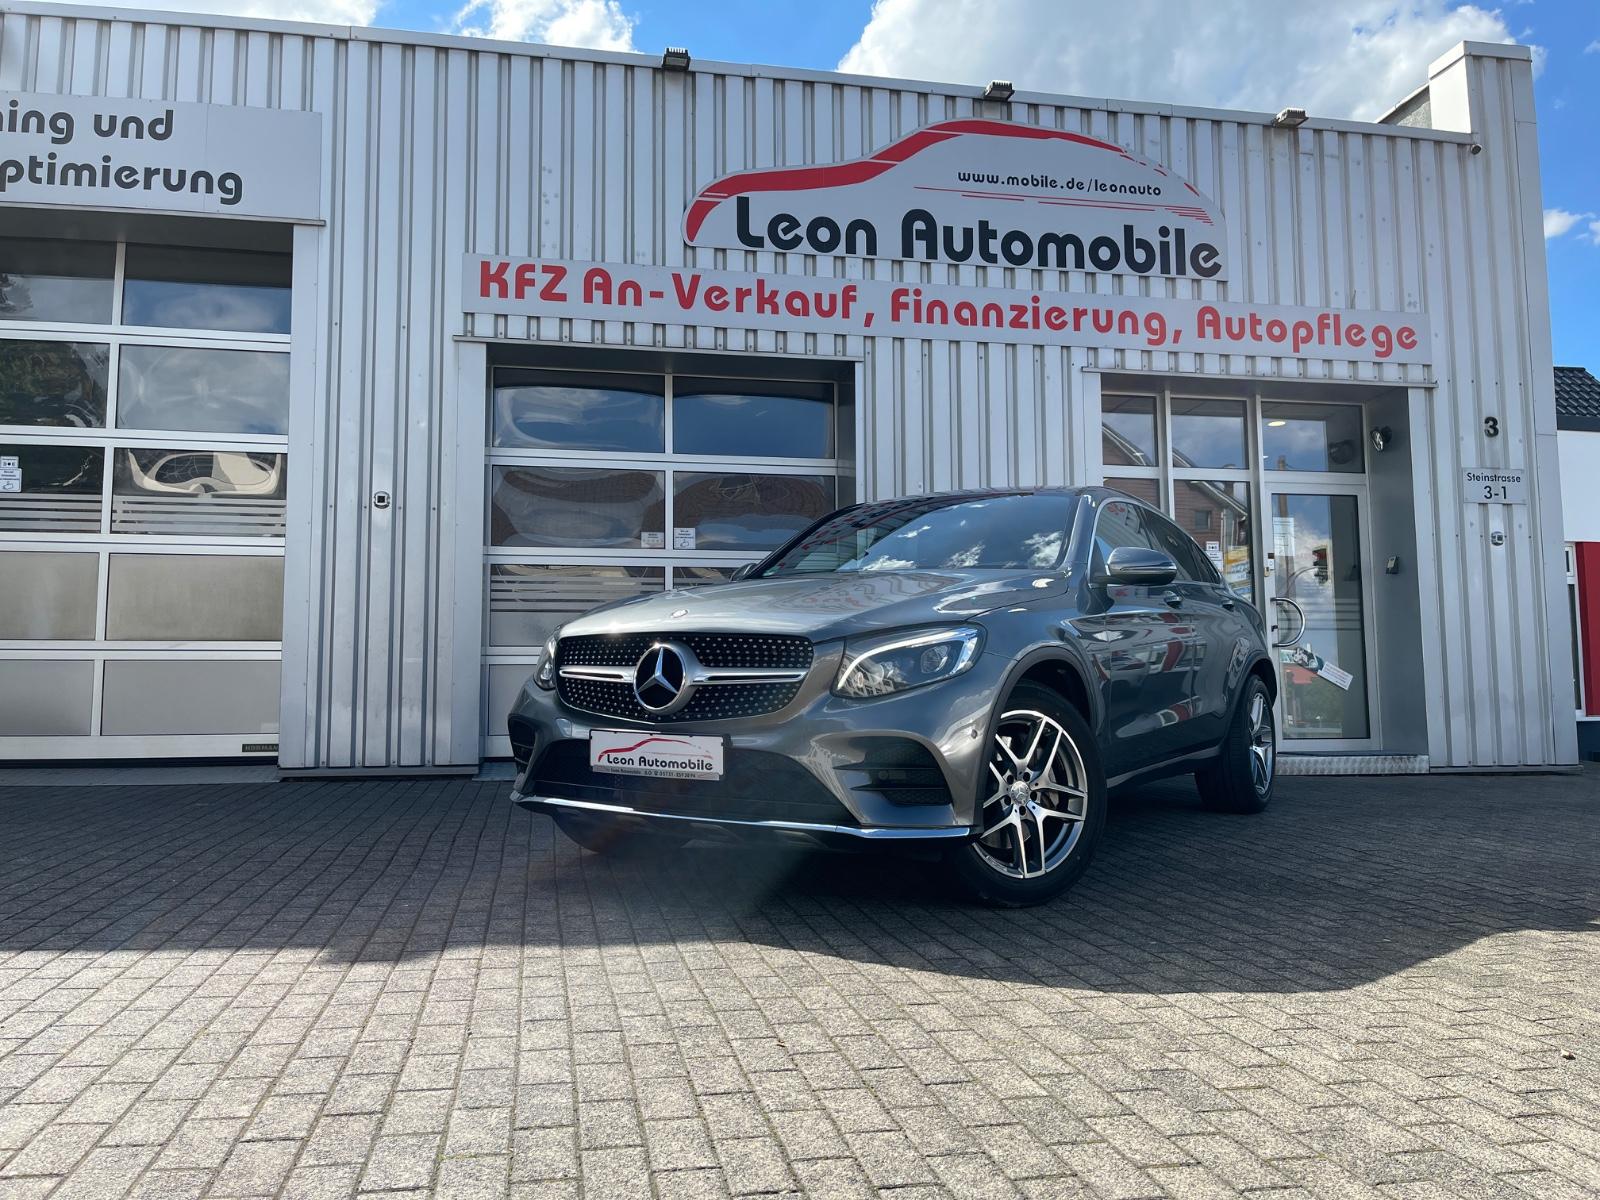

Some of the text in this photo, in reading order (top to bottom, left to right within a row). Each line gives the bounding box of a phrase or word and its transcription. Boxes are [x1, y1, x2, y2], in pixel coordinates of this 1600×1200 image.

[93, 109, 174, 141] und
[957, 170, 1162, 197] www.mobile.de/leonauto
[737, 196, 1222, 278] Leon Automobile
[1197, 305, 1418, 358] Autopflege
[1484, 416, 1499, 438] 3
[1467, 472, 1521, 483] Steinstrasse
[1484, 485, 1507, 499] 3-1
[607, 754, 713, 771] Leon Automobile
